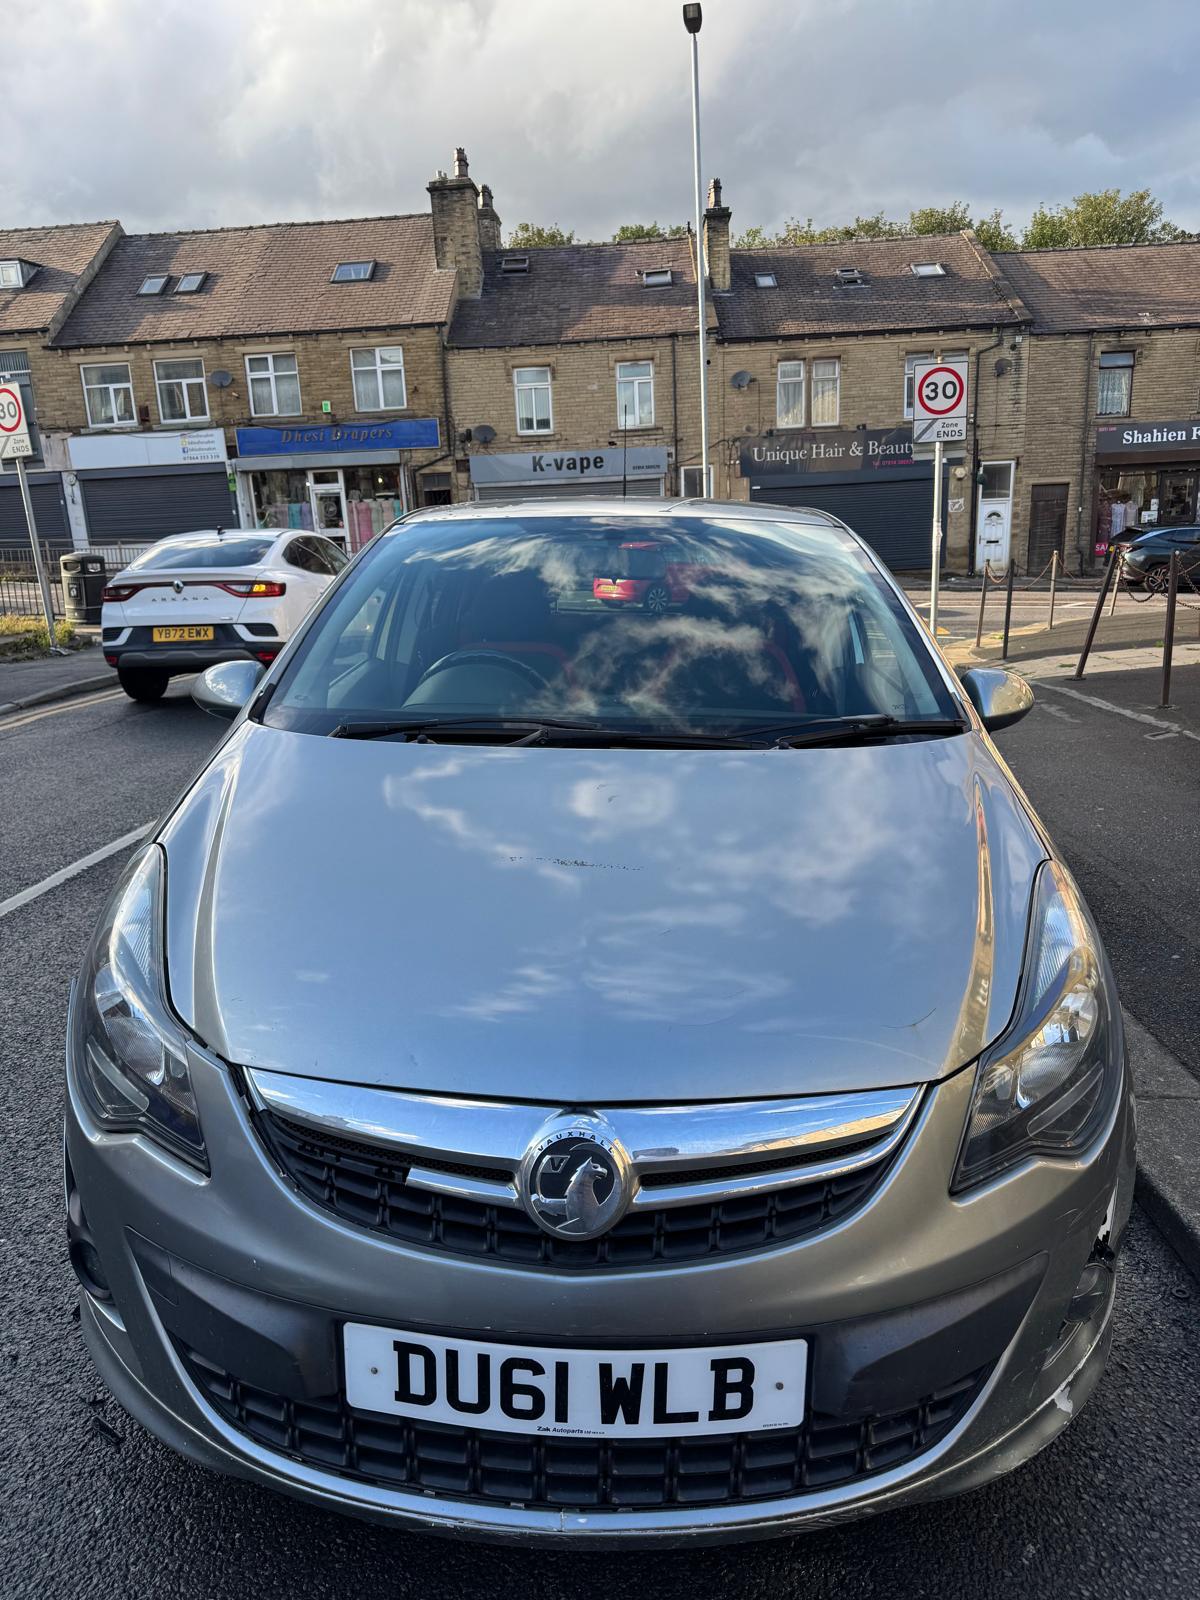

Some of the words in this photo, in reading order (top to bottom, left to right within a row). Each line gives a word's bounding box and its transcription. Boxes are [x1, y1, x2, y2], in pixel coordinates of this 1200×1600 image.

[925, 381, 957, 401] 30
[281, 429, 324, 443] Dhesi
[937, 430, 963, 438] ENDS
[1122, 428, 1186, 444] Shahien
[12, 445, 30, 453] ENDS
[753, 447, 807, 464] Unique
[811, 443, 845, 459] Hair
[849, 441, 863, 457] &
[532, 455, 604, 474] K-vape
[157, 628, 185, 639] YB72
[188, 627, 209, 638] EWX
[537, 1131, 613, 1153] VAUXHALL
[392, 1340, 569, 1424] DU61
[598, 1356, 755, 1424] WLB
